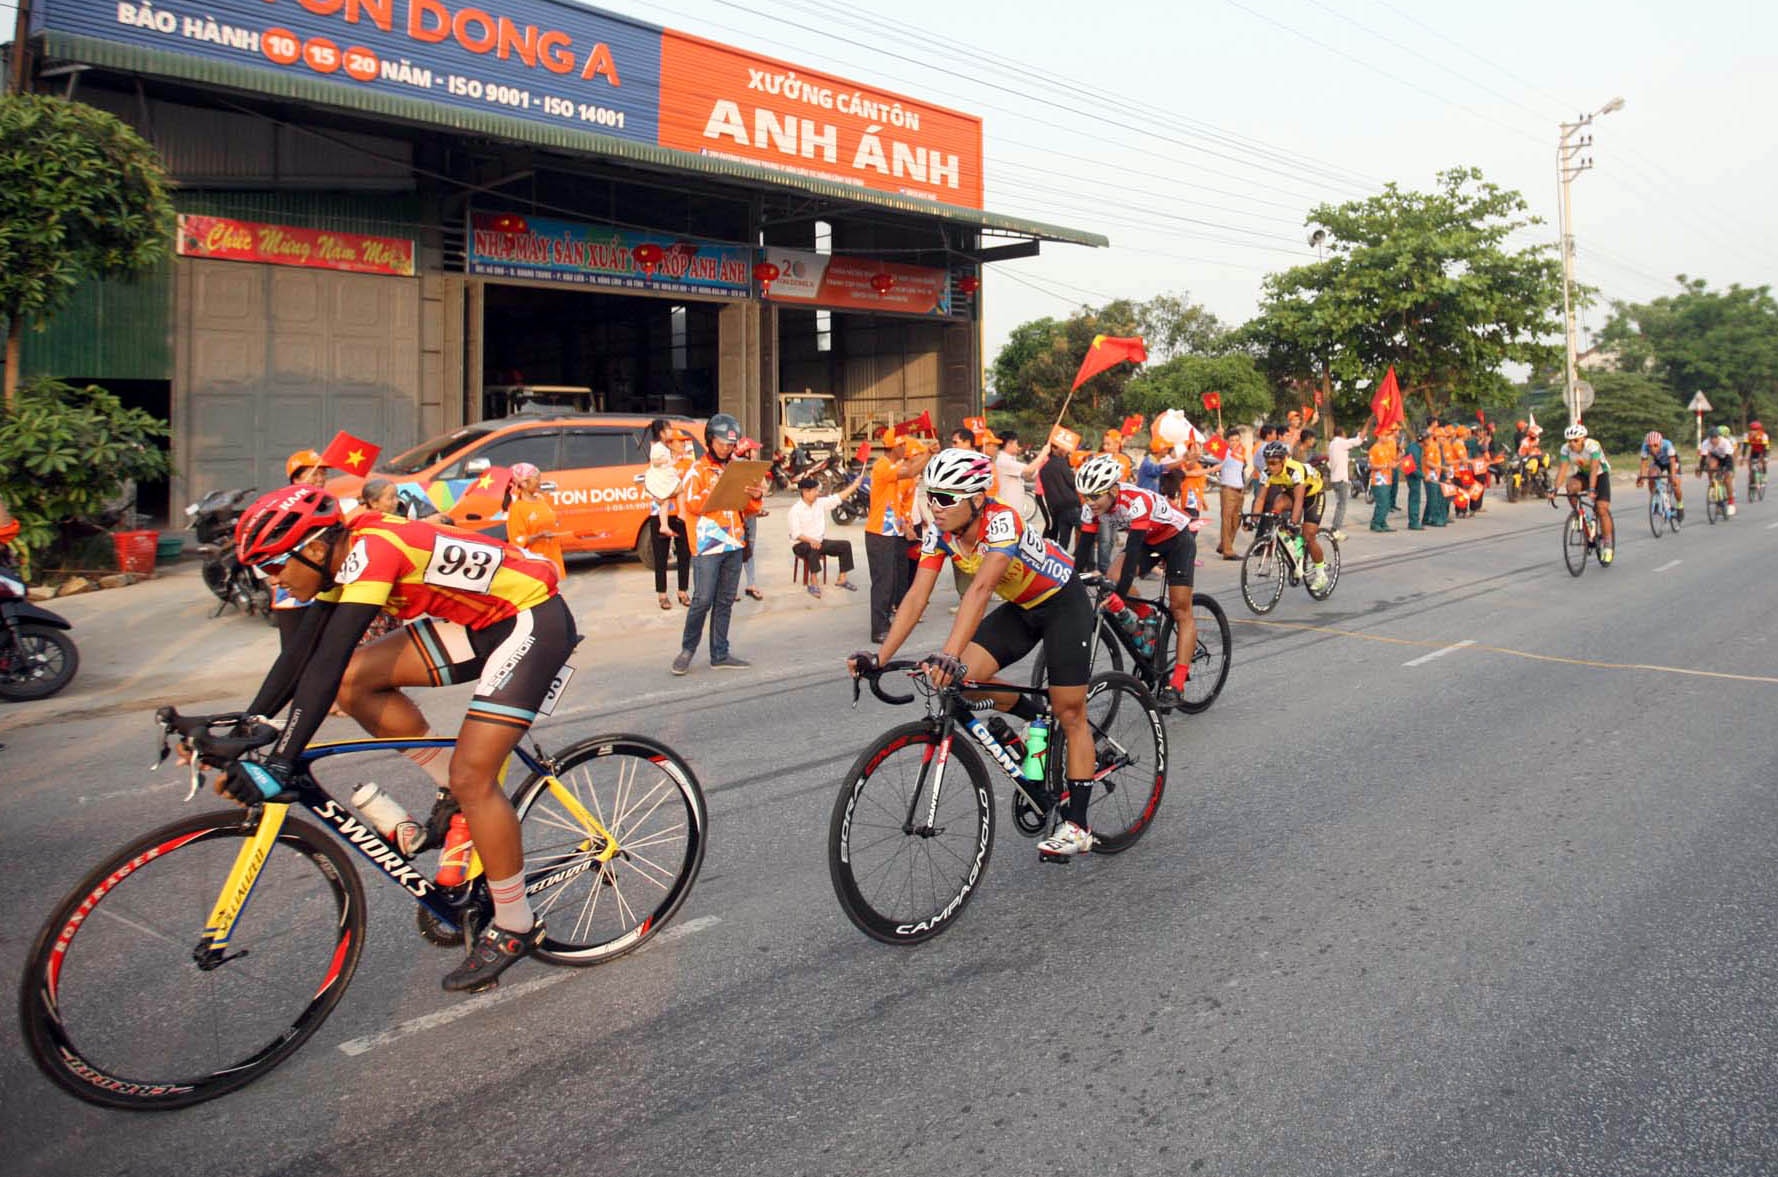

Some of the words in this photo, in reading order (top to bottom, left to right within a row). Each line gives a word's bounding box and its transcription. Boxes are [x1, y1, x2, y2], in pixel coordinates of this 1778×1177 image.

[118, 1, 177, 33] BẢO
[183, 16, 259, 51] HÀNH
[269, 36, 296, 56] 10
[312, 46, 336, 65] 15
[351, 54, 377, 73] 20
[381, 58, 431, 88] NĂM
[448, 75, 483, 98] ISO
[486, 84, 529, 108] 9001
[544, 96, 574, 117] ISO
[578, 104, 624, 128] 14001
[408, 0, 575, 74] DONG
[581, 43, 621, 87] A
[748, 68, 833, 109] XƯỞNG
[703, 99, 837, 164] ANH
[852, 125, 959, 189] ÁNH
[689, 256, 718, 281] ANH
[551, 490, 588, 505] TON
[591, 487, 638, 503] DONG
[437, 544, 493, 580] 93
[971, 723, 1024, 778] GIANT
[1149, 710, 1165, 772] BORA
[312, 800, 435, 896] S-WORKS
[840, 777, 865, 863] BORA
[895, 788, 990, 934] CAMPAGNOLO
[54, 848, 160, 951] BONTRAGER
